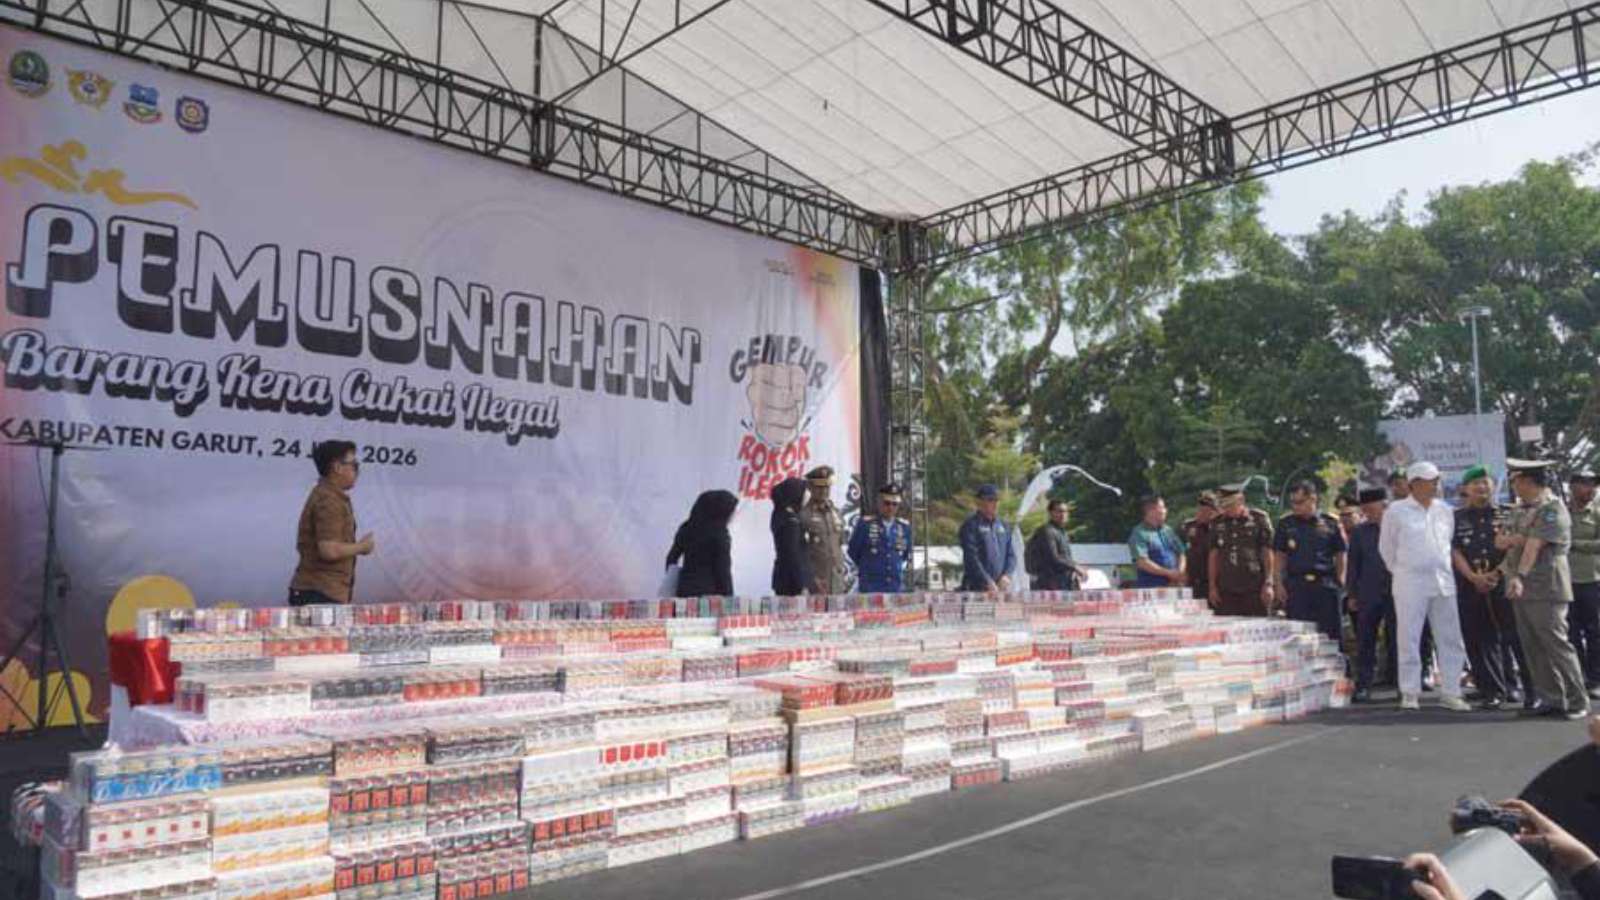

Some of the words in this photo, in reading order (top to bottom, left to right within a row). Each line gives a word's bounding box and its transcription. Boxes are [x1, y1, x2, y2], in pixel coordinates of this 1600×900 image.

[6, 203, 702, 405] PEMUSNAHAN
[1, 328, 209, 418] Barang
[217, 353, 334, 416] Kena
[340, 368, 456, 428] Cukai
[462, 383, 560, 446] Ilegal
[729, 333, 829, 389] GEMPUR
[0, 417, 165, 449] KABUPATEN
[171, 430, 263, 458] GARUT,
[271, 437, 302, 458] 24
[361, 445, 418, 467] 2026
[736, 433, 810, 472] ROKOK
